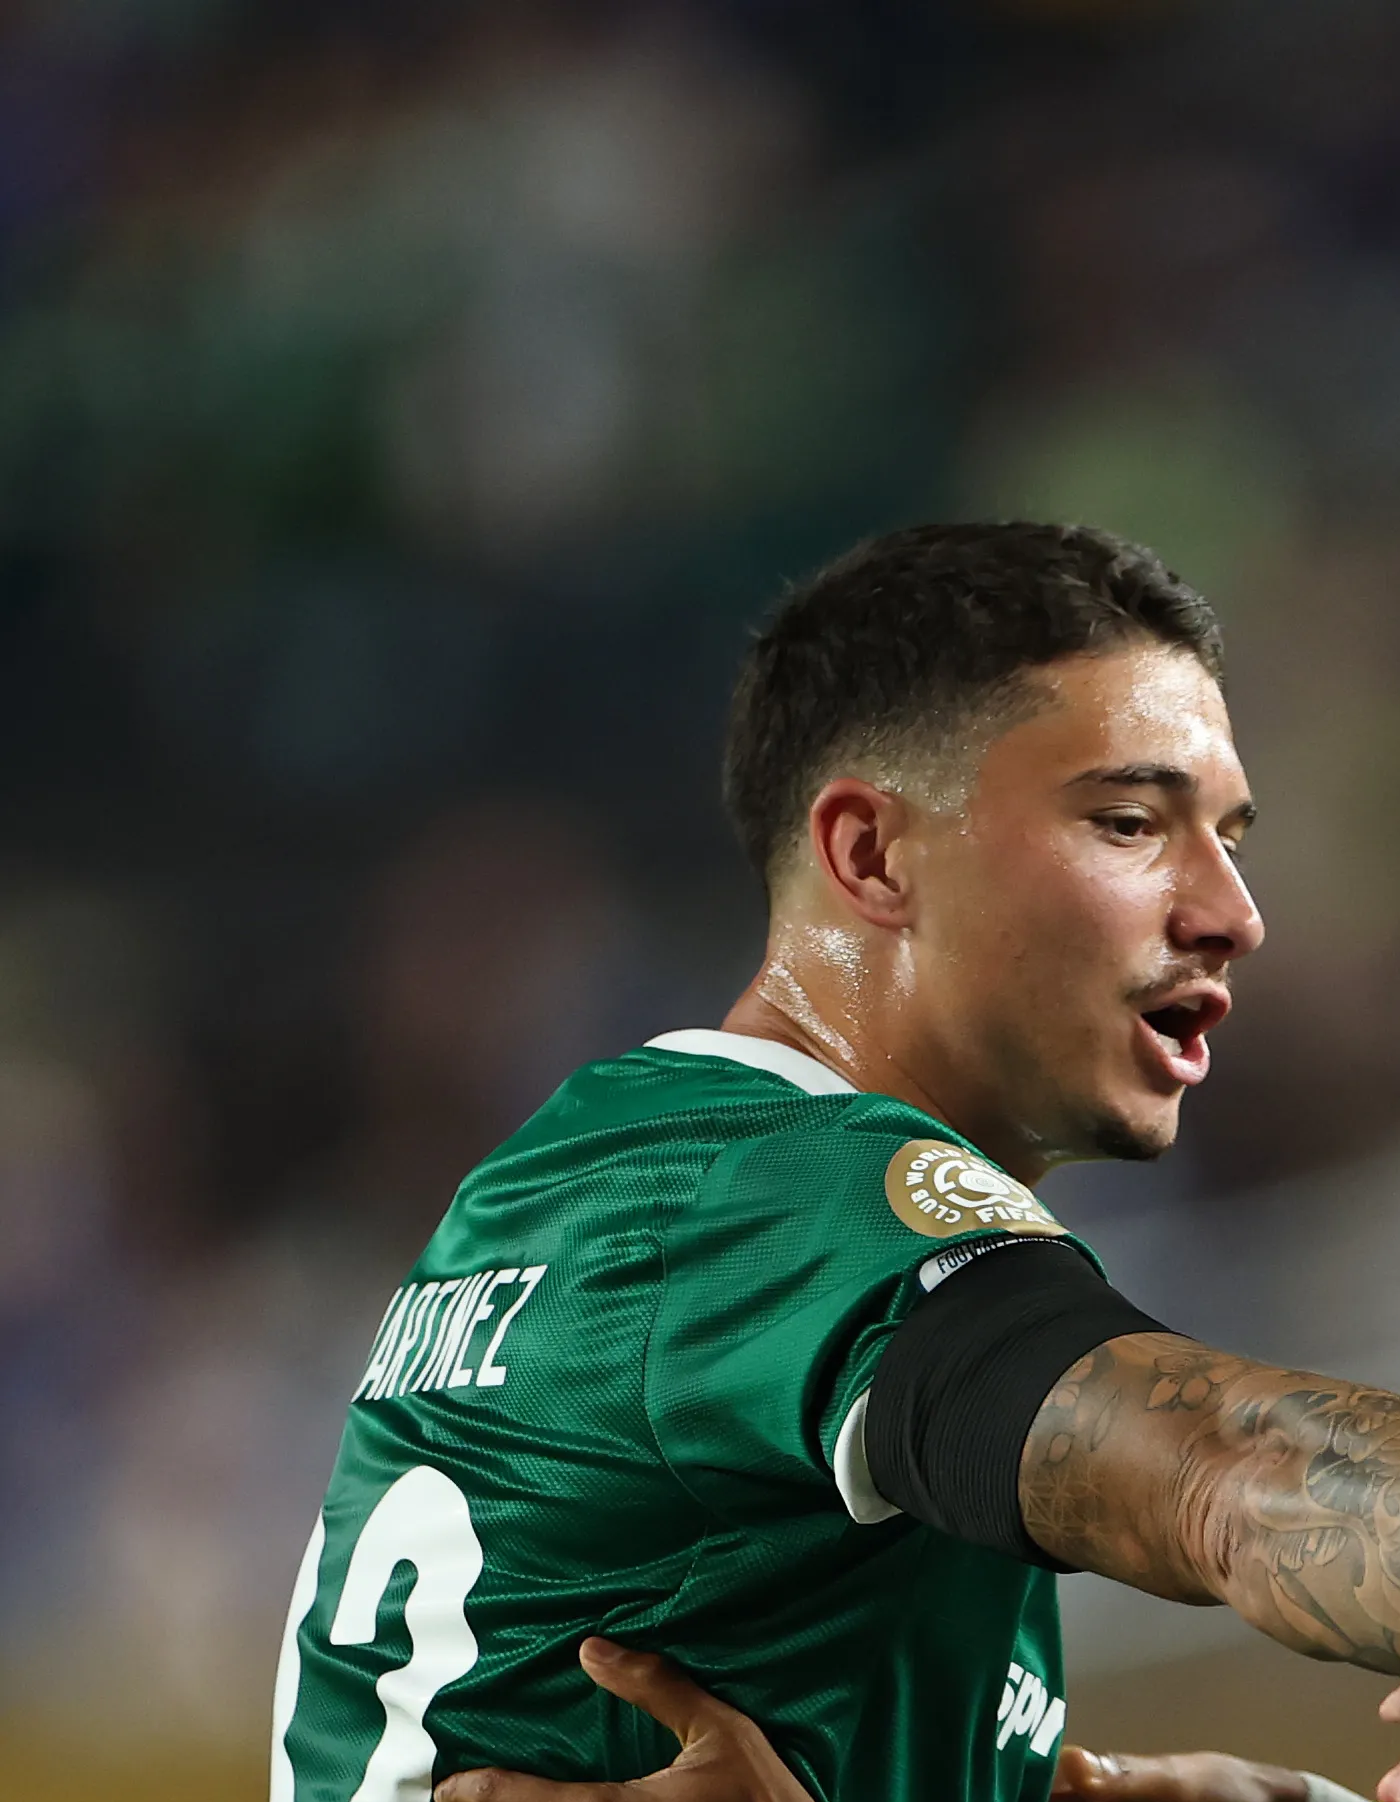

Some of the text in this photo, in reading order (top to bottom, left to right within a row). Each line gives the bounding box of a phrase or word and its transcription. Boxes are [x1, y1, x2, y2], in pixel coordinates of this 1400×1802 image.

[906, 1148, 963, 1224] CLUB WORLD
[974, 1206, 1049, 1226] FIFA
[350, 1264, 549, 1404] ARTINEZ
